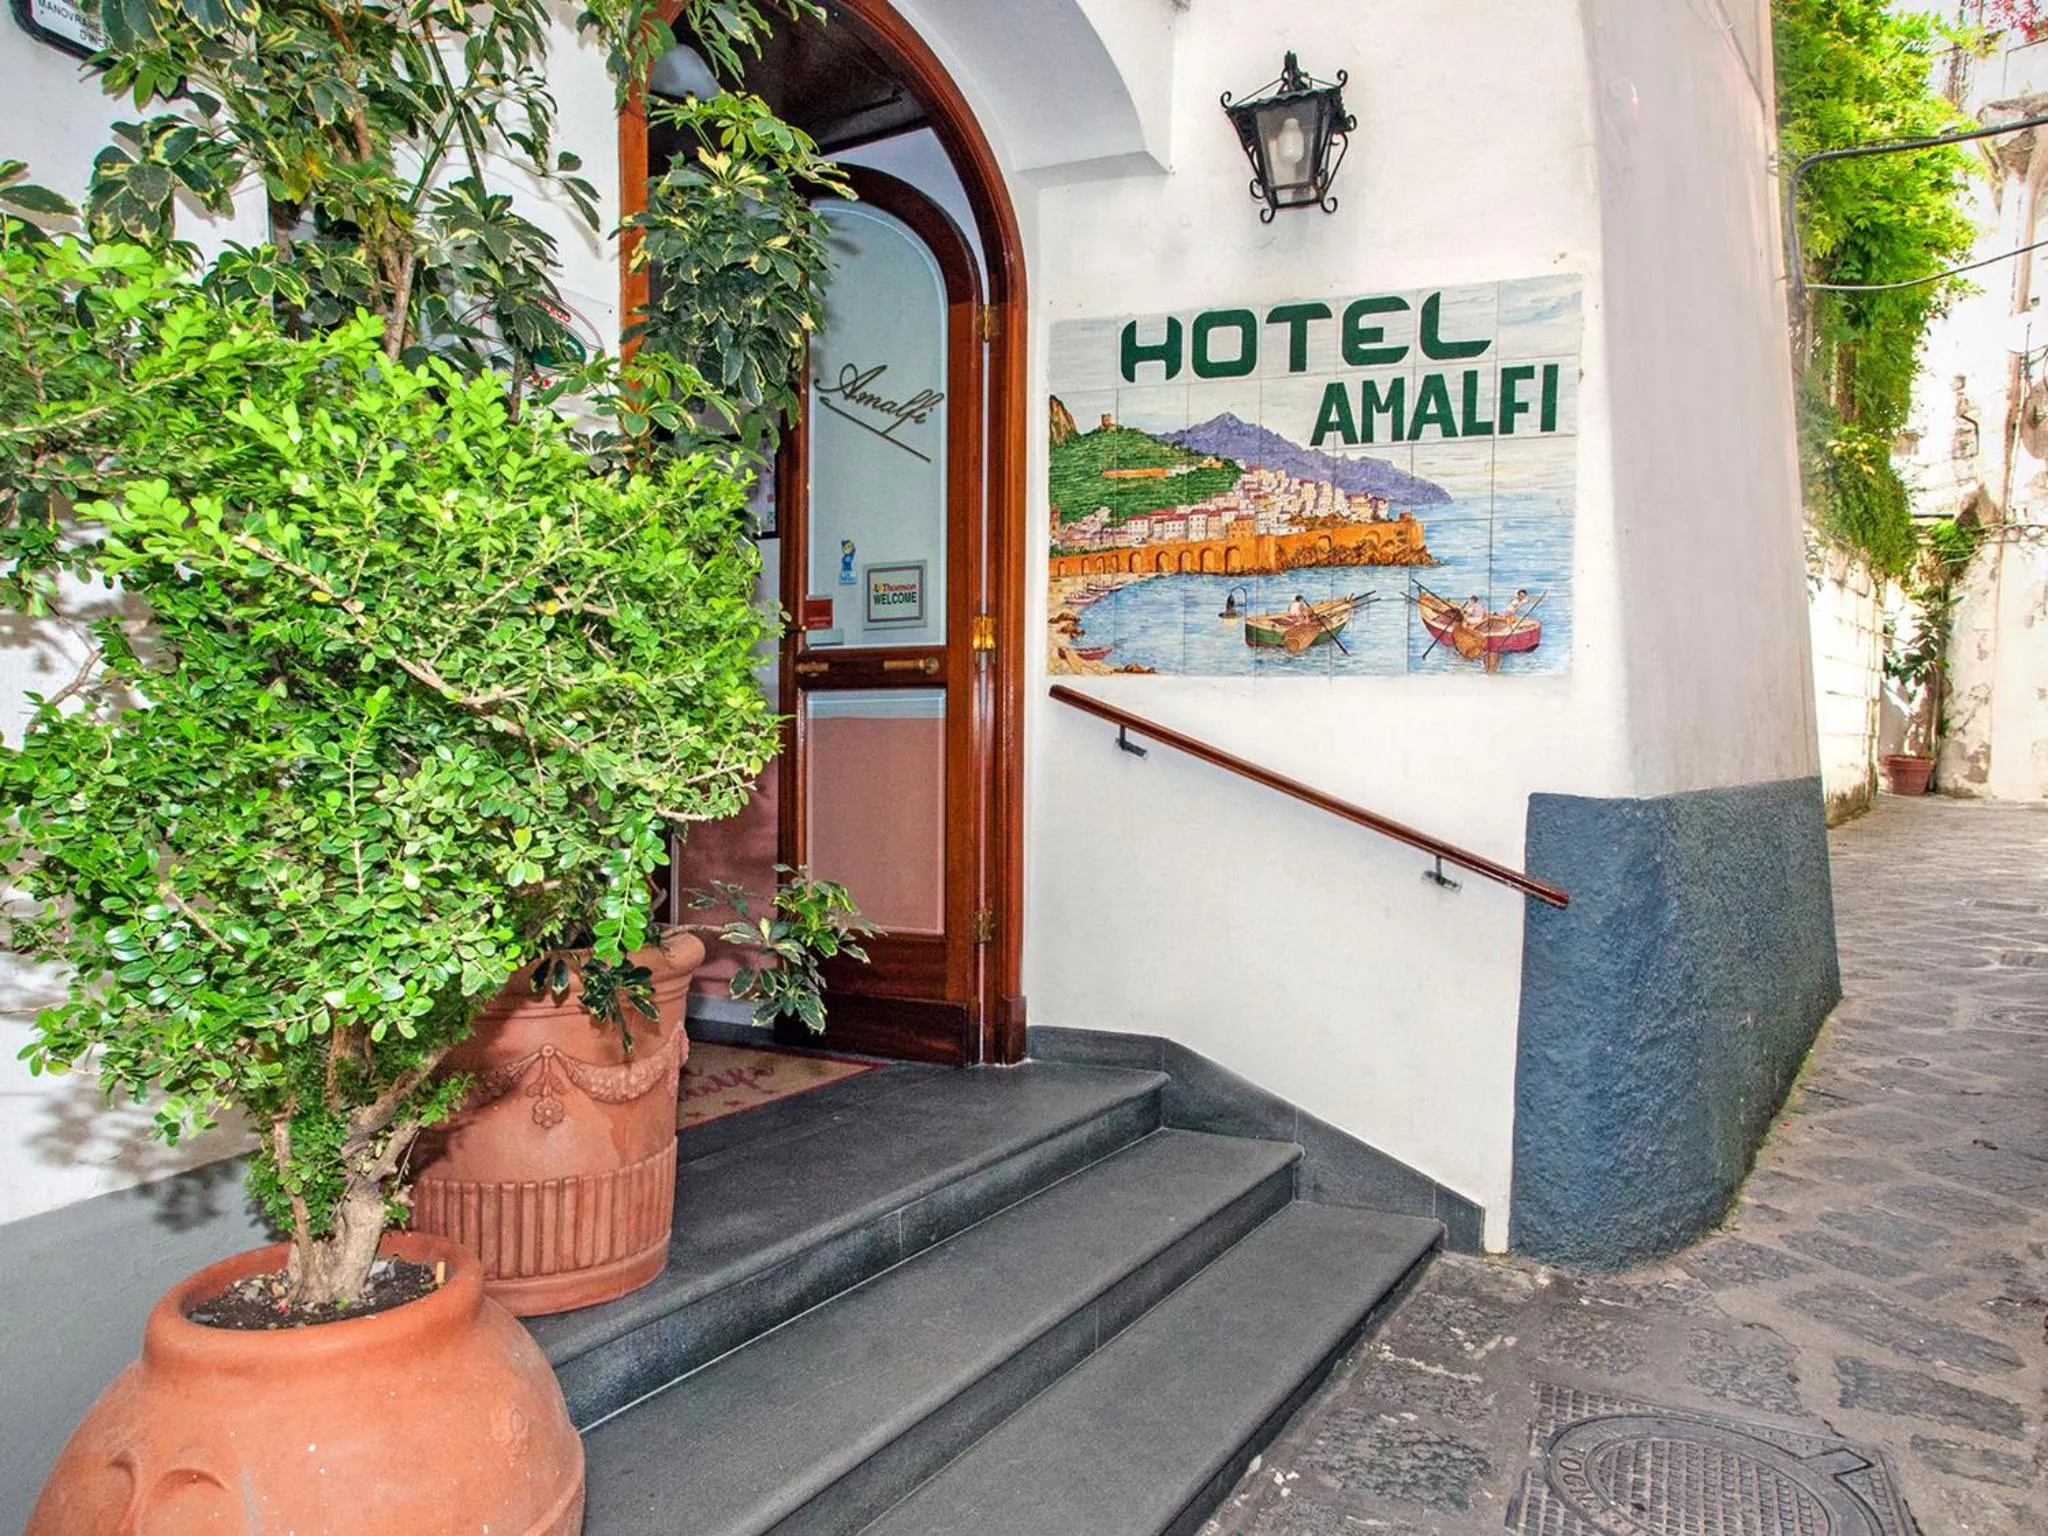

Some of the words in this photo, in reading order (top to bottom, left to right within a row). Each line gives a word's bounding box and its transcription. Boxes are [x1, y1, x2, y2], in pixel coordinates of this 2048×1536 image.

[1119, 290, 1492, 383] HOTEL
[813, 362, 945, 436] Amalfi
[1310, 363, 1559, 447] AMALFI
[873, 591, 917, 605] WELCOME
